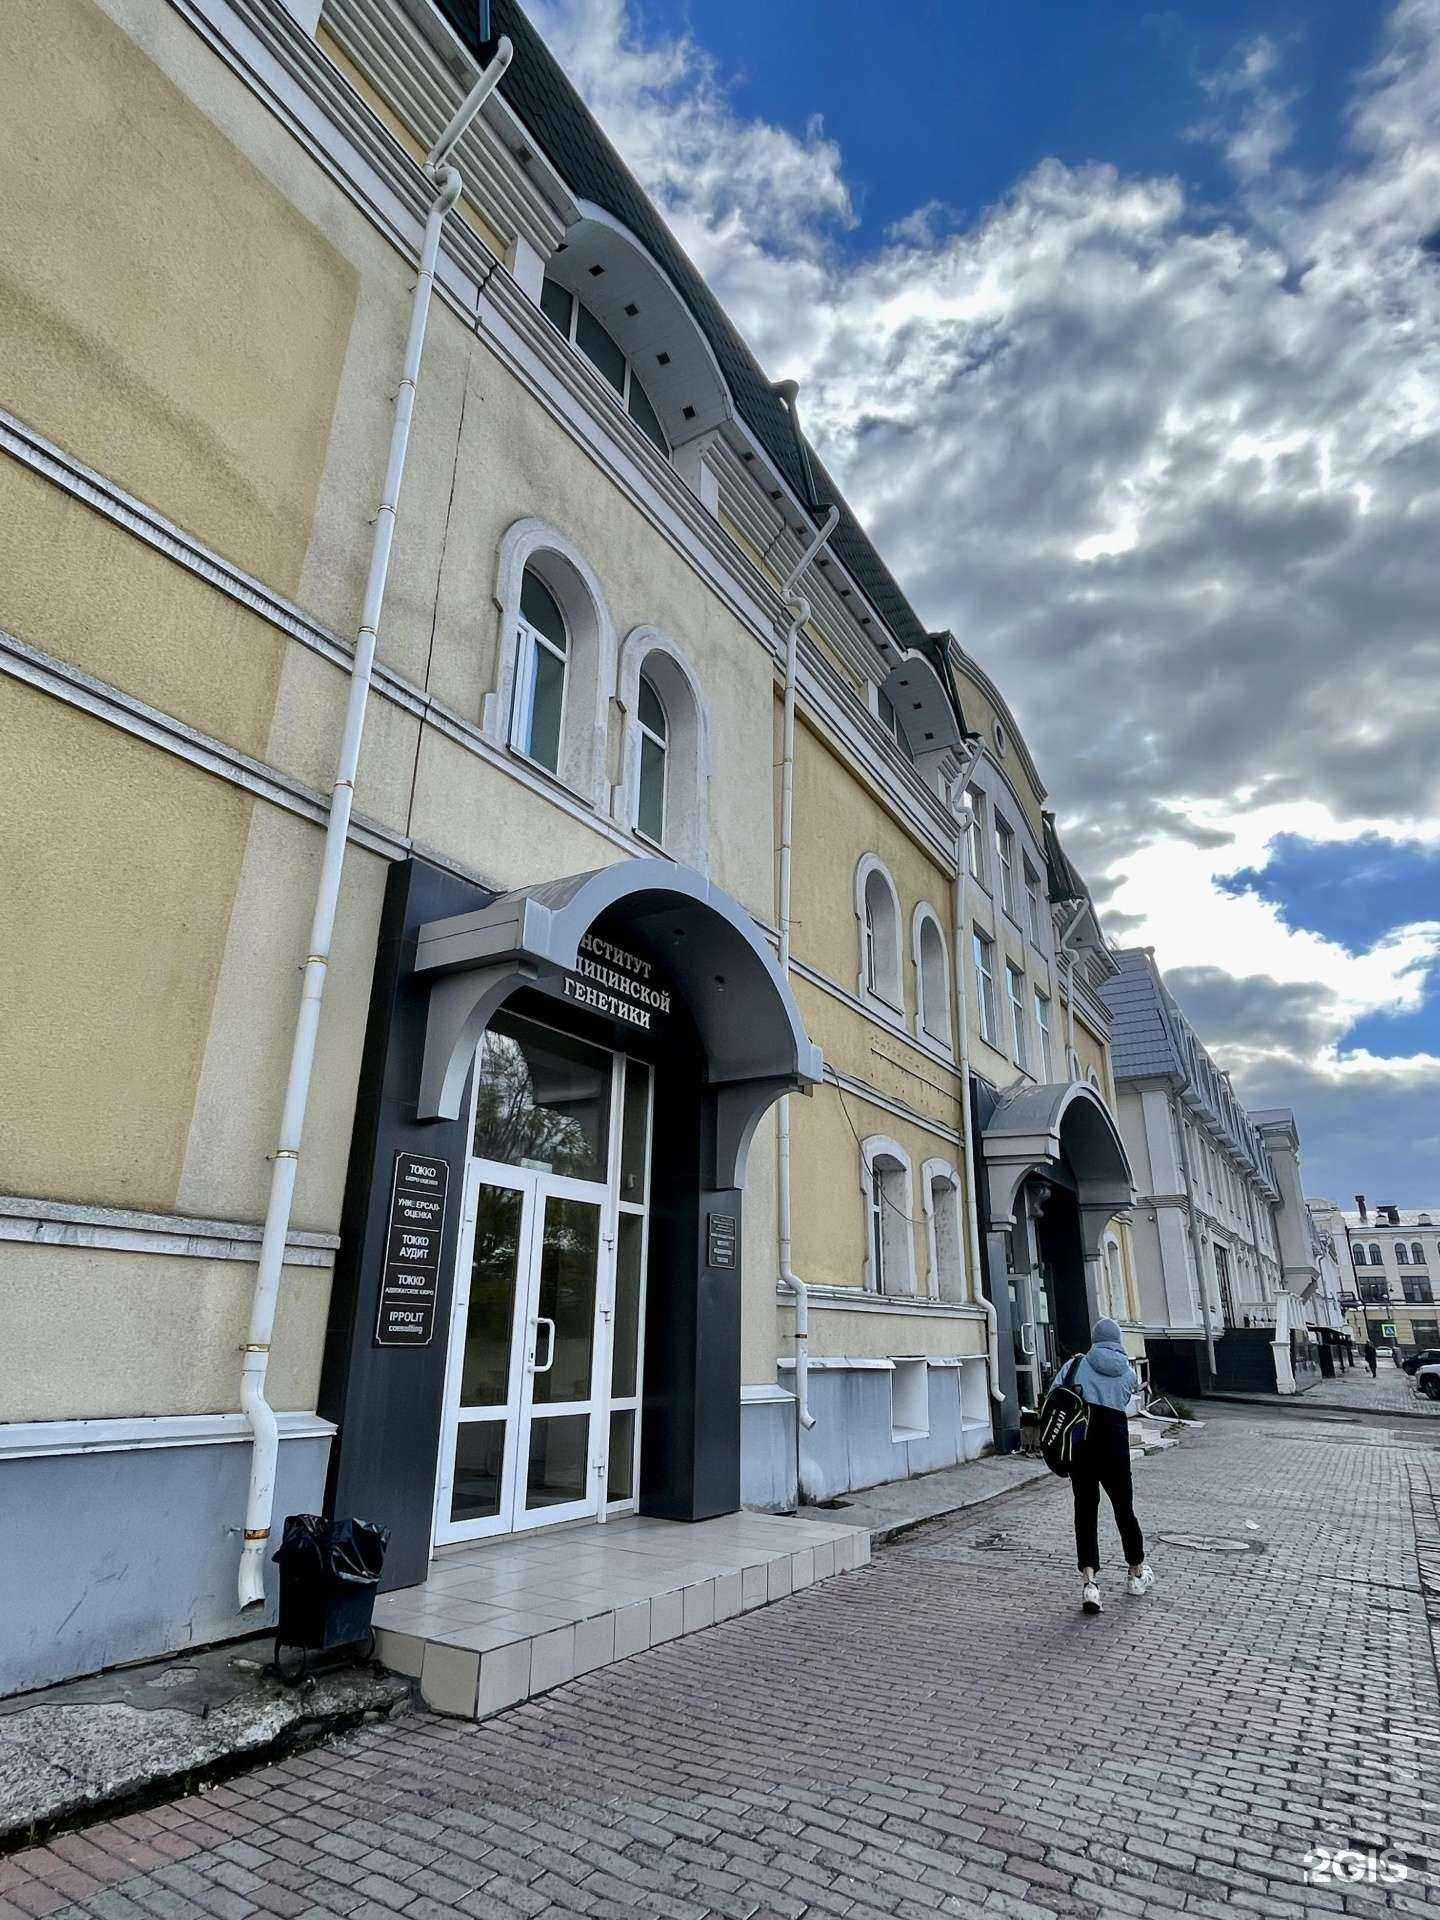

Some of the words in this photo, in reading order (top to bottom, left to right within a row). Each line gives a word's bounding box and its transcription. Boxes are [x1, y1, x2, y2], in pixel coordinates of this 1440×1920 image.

[563, 976, 651, 1029] ГЕНЕТИКИ
[409, 1164, 436, 1177] ТОККО
[404, 1209, 433, 1220] ОЦЕНКА
[402, 1234, 429, 1246] ТОККО
[399, 1246, 429, 1260] АУДИТ
[398, 1274, 425, 1286] ТОККО
[389, 1311, 424, 1322] IPPOLIT
